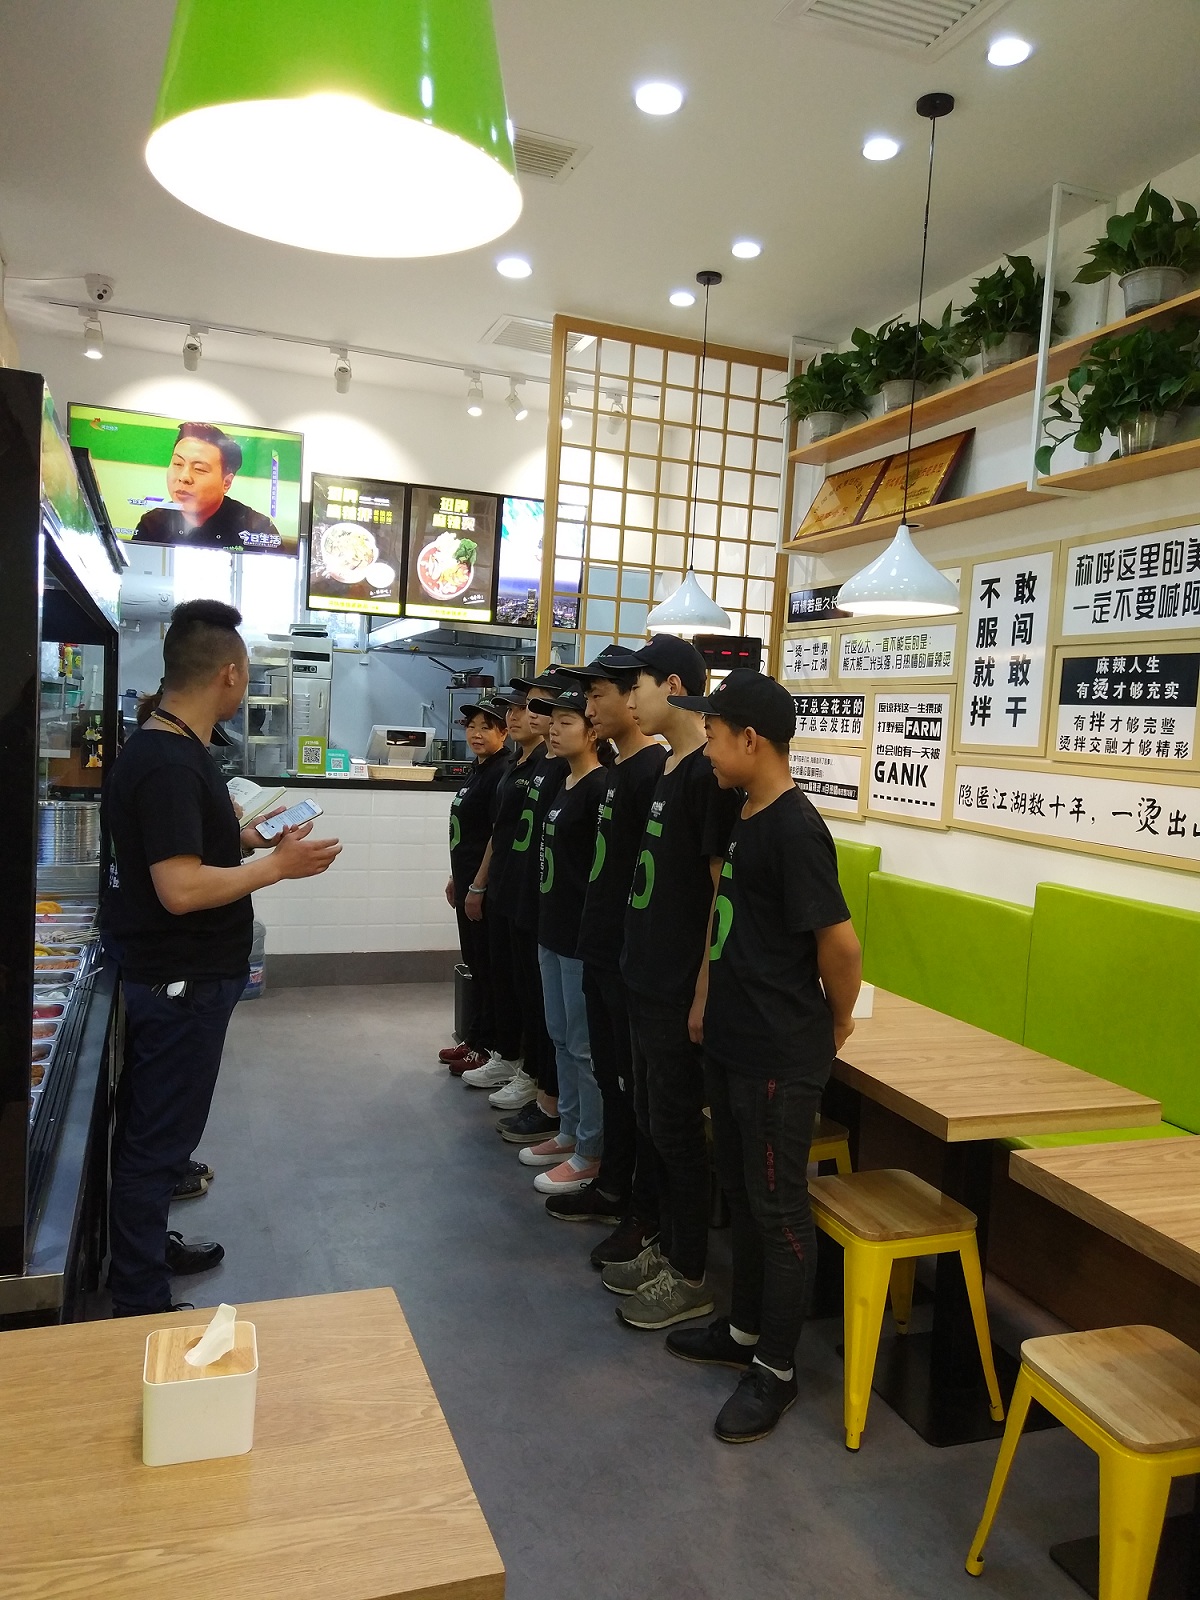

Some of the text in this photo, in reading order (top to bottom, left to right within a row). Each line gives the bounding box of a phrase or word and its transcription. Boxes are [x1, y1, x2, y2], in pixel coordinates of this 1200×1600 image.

[786, 642, 828, 657] 一烫一世界
[970, 577, 1001, 727] 不服就拌
[1005, 571, 1037, 727] 敢闯敢干
[786, 658, 827, 673] 一拌一江湖
[1096, 656, 1160, 674] 麻辣人生
[1077, 678, 1179, 700] 有烫才够充实
[878, 703, 942, 714] 原谅我这一生猥琐
[795, 717, 862, 734] 子总会发狂的
[877, 720, 941, 737] 打野爱 FARM
[1073, 710, 1176, 735] 有拌才够完整
[876, 744, 940, 760] 也会怕有一天被
[1058, 735, 1190, 759] 烫拌交融才够精彩
[874, 760, 929, 788] GANK
